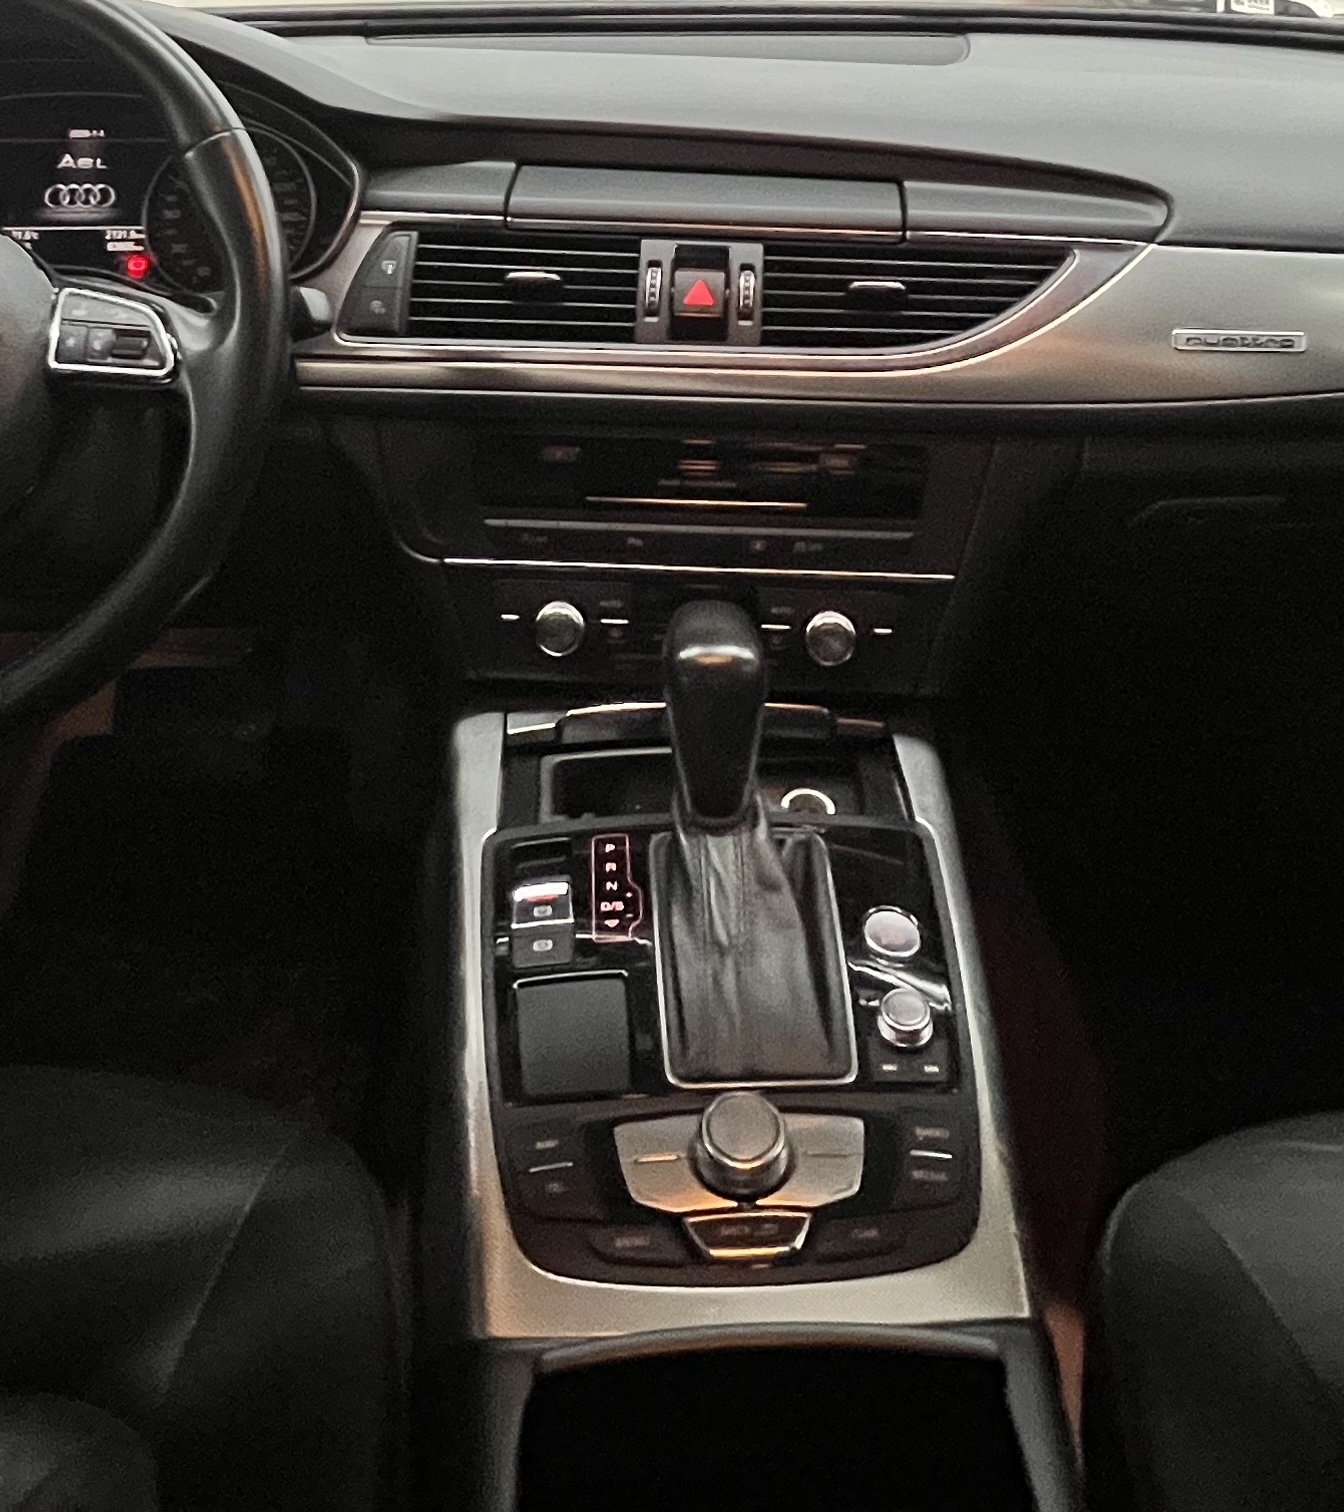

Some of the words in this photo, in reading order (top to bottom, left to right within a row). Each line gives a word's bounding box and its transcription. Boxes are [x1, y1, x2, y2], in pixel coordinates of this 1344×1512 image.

[57, 153, 108, 169] A6L
[605, 843, 616, 853] P
[606, 880, 618, 891] N
